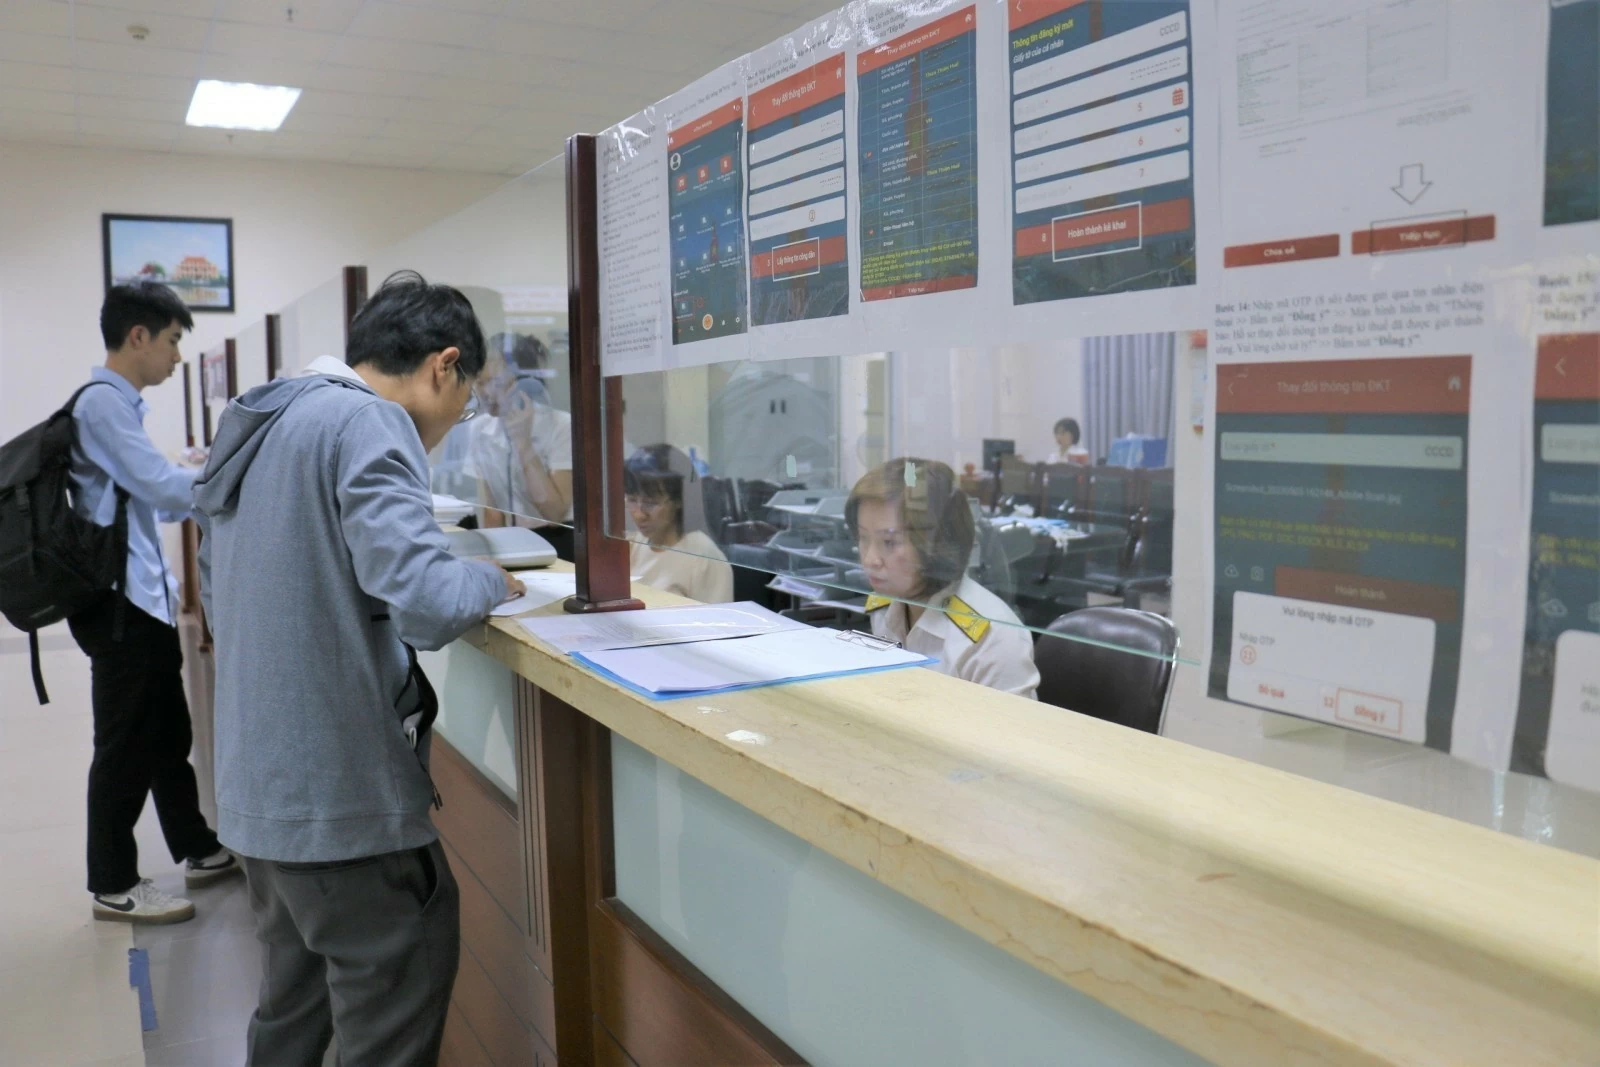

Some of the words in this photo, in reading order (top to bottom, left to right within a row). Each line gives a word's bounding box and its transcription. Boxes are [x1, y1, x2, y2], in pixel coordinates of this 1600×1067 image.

[1012, 35, 1030, 49] Thông
[1038, 28, 1054, 40] đăng
[1062, 18, 1074, 32] mới
[1159, 22, 1180, 36] CCCD
[1068, 227, 1084, 238] Hoàn
[1399, 230, 1422, 243] Tiếp
[1263, 248, 1283, 257] Chia
[1292, 296, 1312, 306] OTP
[1277, 381, 1300, 395] Thay
[1300, 380, 1318, 392] đổi
[1320, 380, 1348, 395] thông
[1351, 380, 1366, 392] tin
[1367, 378, 1392, 392] ĐKT
[1424, 445, 1454, 458] CCCD
[1283, 606, 1296, 616] Vui
[1298, 608, 1315, 622] lòng
[1316, 611, 1336, 624] nhập
[1338, 614, 1352, 625] mã
[1355, 616, 1374, 628] OTP
[1239, 632, 1257, 645] Nhập
[1259, 635, 1275, 646] OTP
[1354, 705, 1378, 722] Đồng
